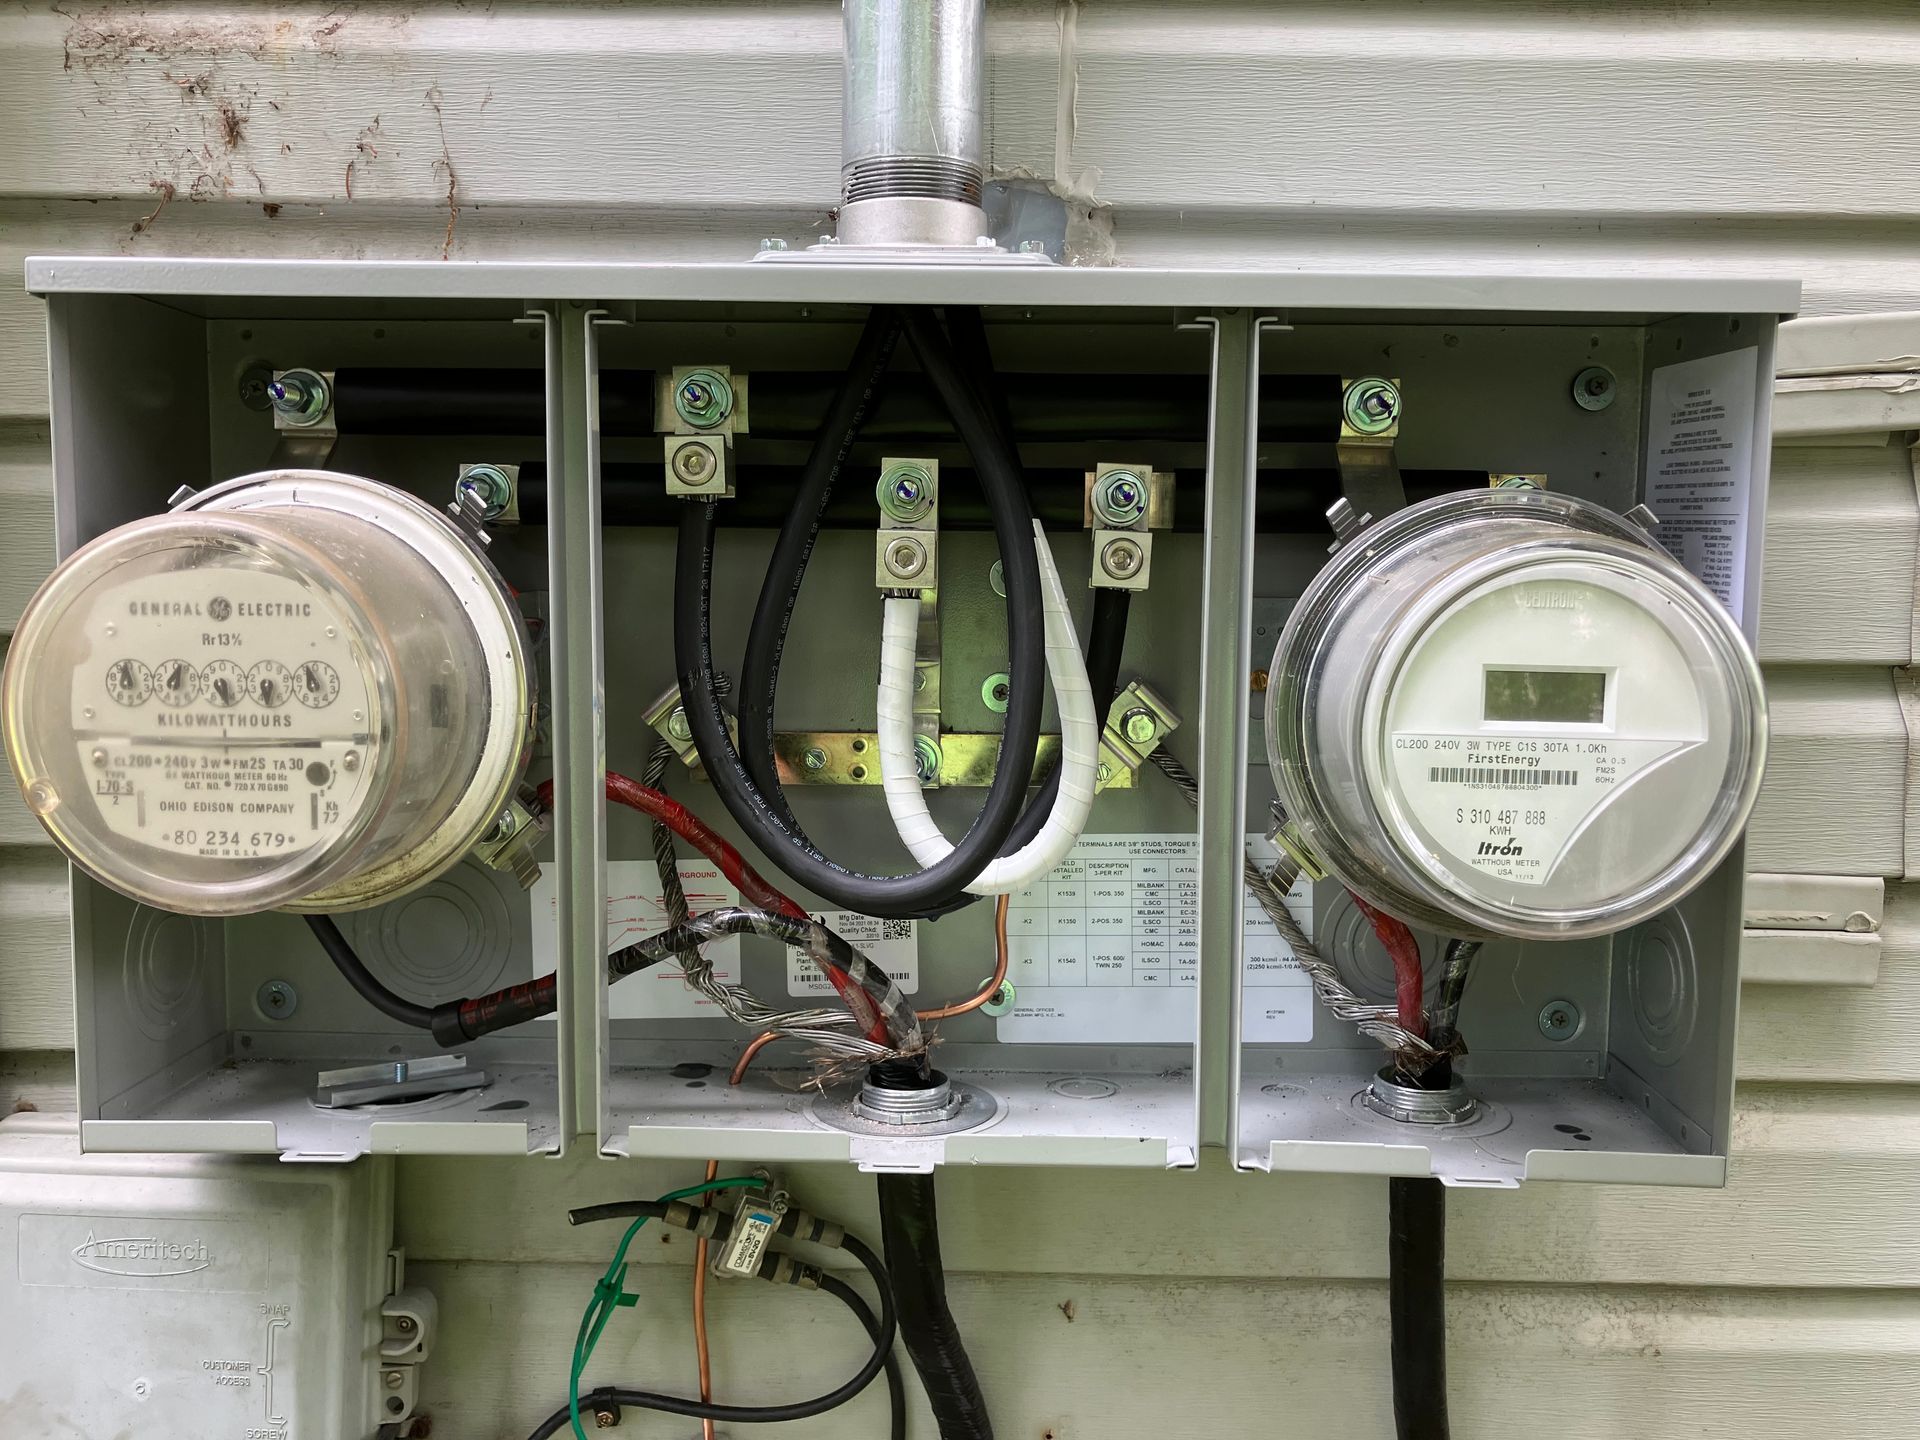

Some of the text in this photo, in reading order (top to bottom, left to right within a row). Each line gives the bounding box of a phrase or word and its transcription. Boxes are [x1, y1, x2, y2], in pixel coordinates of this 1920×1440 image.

[130, 602, 311, 617] GENERAL ELECTRIC
[158, 714, 292, 728] KILOWATTHOURS
[1396, 739, 1606, 753] CL200 240V 3W TYPE C1S 30TA 1.0Kh
[1468, 754, 1540, 767] FirstEnergy
[182, 772, 262, 781] WATTHOUR METER
[113, 796, 119, 805] 2
[326, 802, 338, 811] Kh
[160, 802, 294, 814] OHIO EDISON COMPANY
[1456, 808, 1545, 825] S 310 487 888
[1489, 826, 1511, 835] KWH
[174, 830, 285, 847] 80 234 679
[1478, 837, 1522, 856] Itron
[79, 1229, 209, 1261] Ameritech
[259, 1303, 290, 1316] SNAP
[202, 1360, 251, 1372] CUSTOMER
[216, 1376, 251, 1387] ACCESS
[247, 1429, 287, 1440] SCREW
